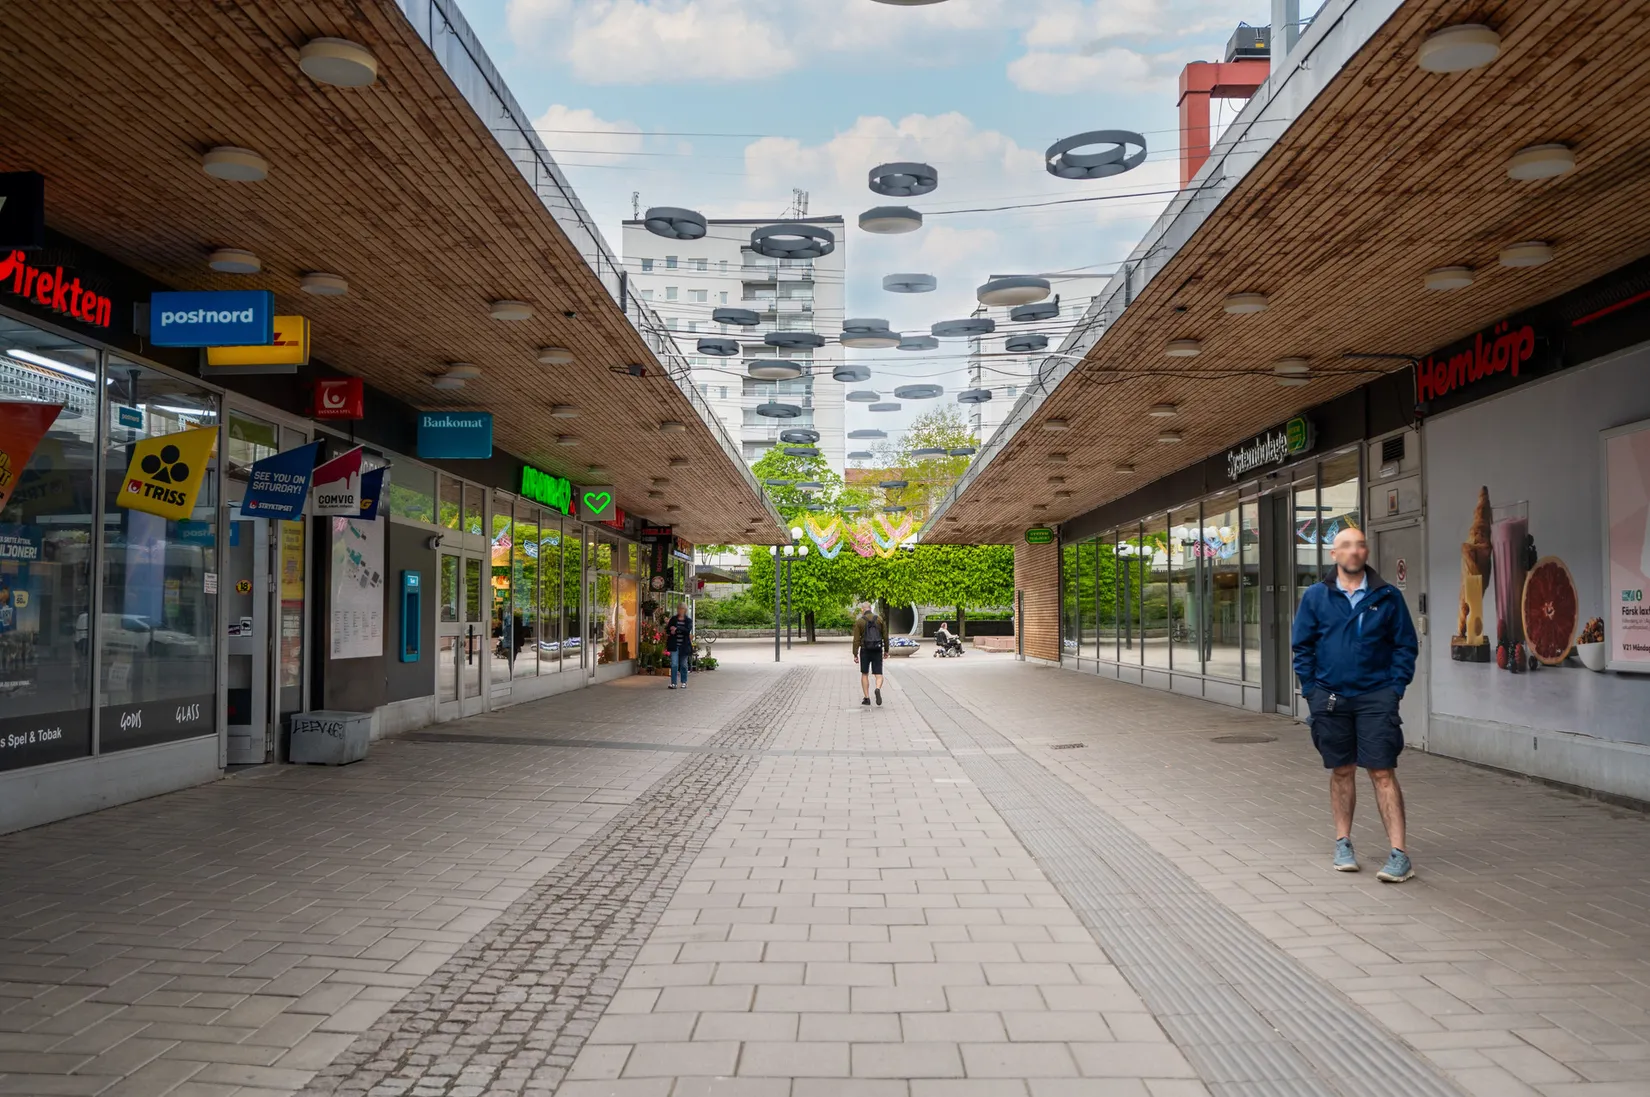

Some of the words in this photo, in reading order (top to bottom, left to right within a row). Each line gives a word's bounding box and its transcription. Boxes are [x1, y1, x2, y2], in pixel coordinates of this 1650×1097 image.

[161, 308, 253, 326] postnord
[1417, 320, 1535, 403] Hemköp
[423, 416, 483, 428] Bankomat
[1227, 430, 1288, 480] Systembolage
[253, 471, 271, 482] SEE
[273, 473, 291, 484] YOU
[293, 475, 306, 485] ON
[143, 482, 187, 506] TRISS
[252, 481, 302, 495] SATURDAY!
[258, 501, 294, 512] STRYKTIPSET
[318, 495, 354, 505] COMVIQ
[0, 544, 38, 559] ILJONER!
[1622, 606, 1638, 616] Färsk
[120, 709, 142, 731] GODIS
[175, 703, 200, 724] GLASS
[8, 731, 27, 749] Spel
[29, 732, 36, 743] &
[38, 727, 63, 742] Tobak
